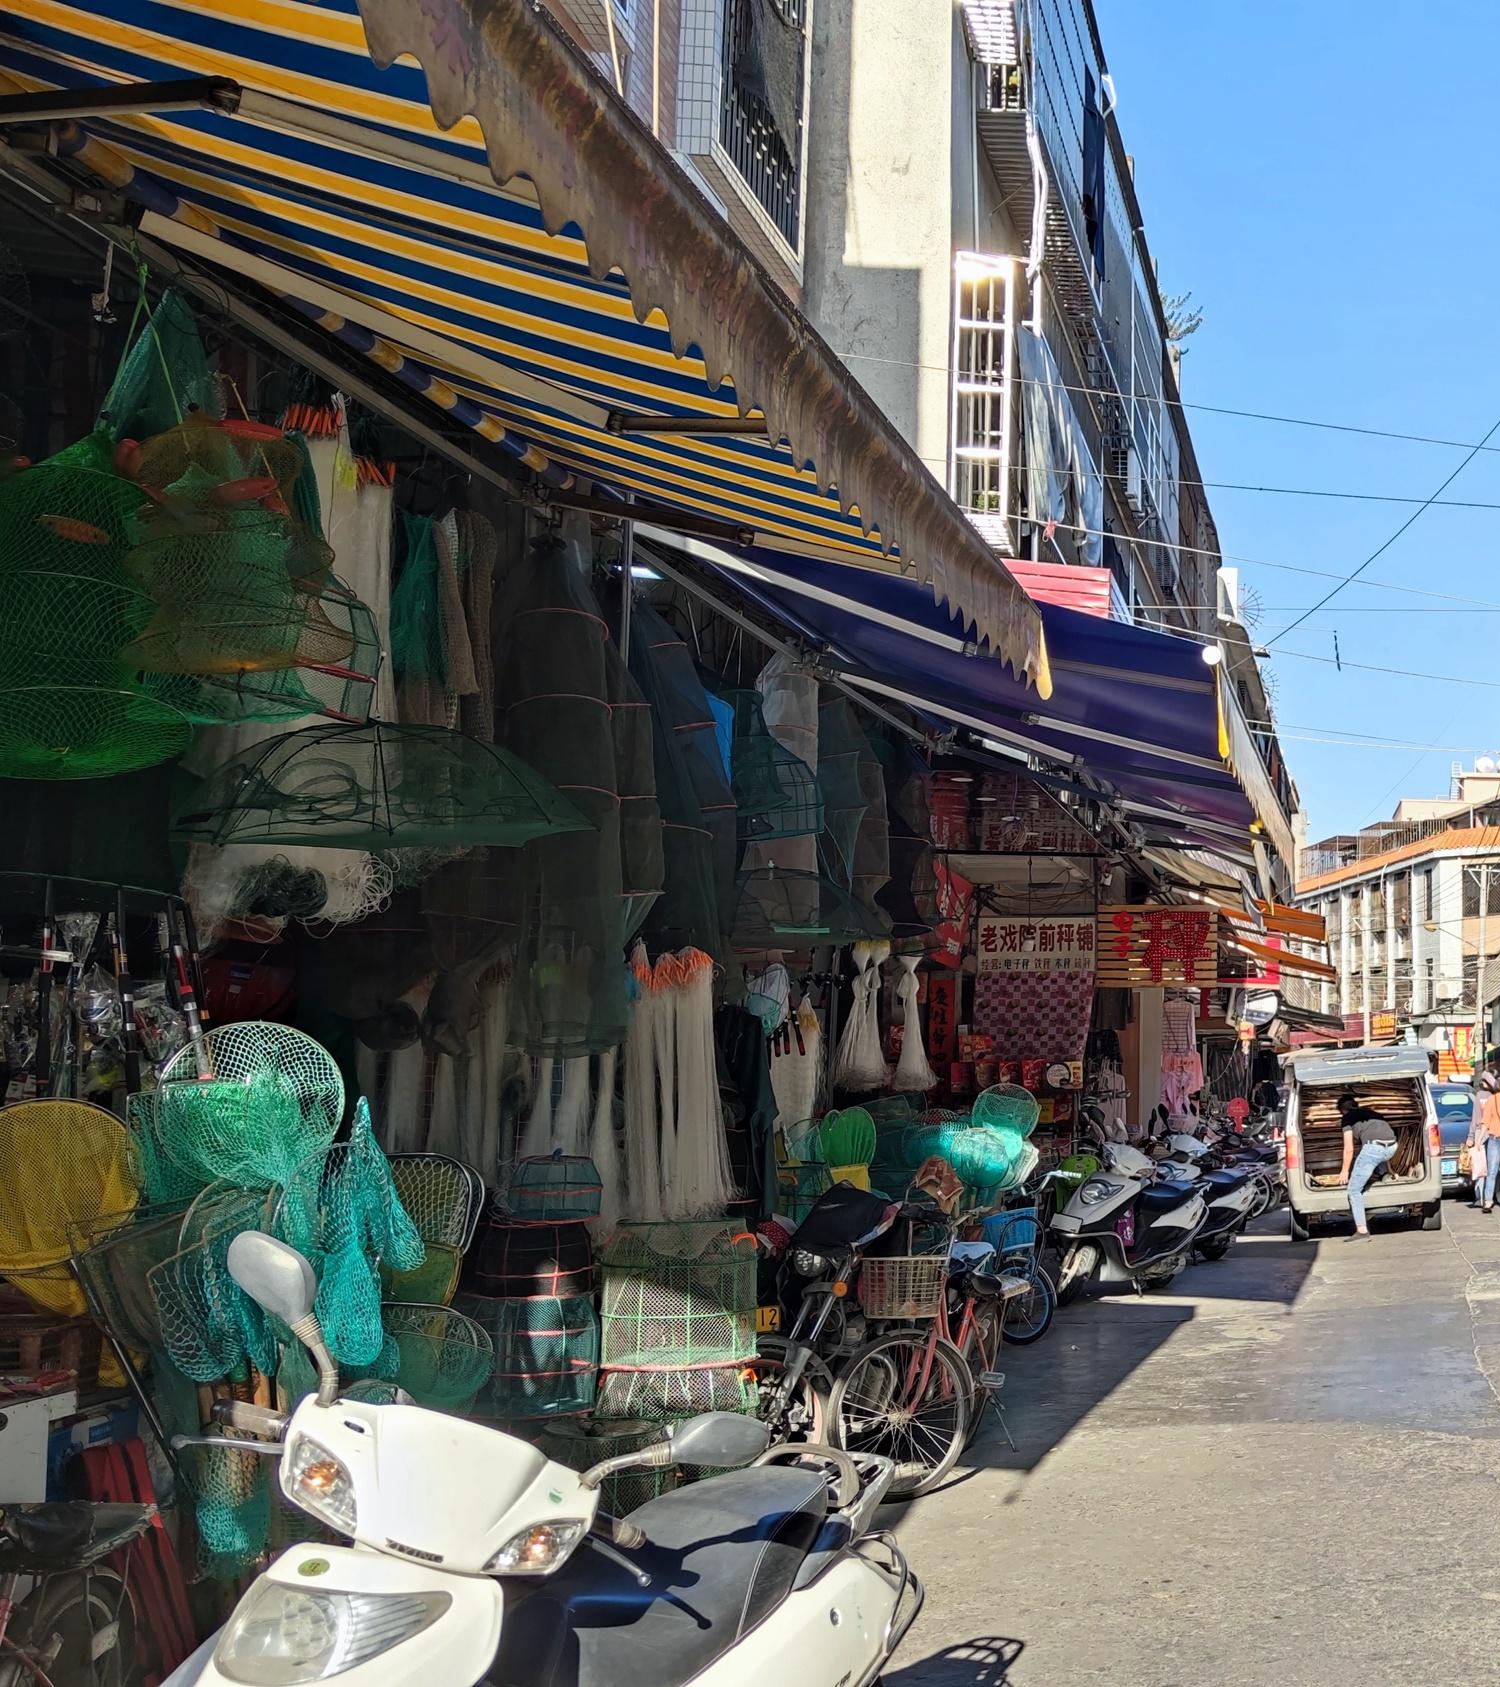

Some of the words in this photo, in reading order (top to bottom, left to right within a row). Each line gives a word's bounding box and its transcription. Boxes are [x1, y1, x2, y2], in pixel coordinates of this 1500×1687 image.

[1112, 911, 1135, 958] 电子
[1140, 908, 1212, 983] 秤
[761, 1308, 777, 1327] 12
